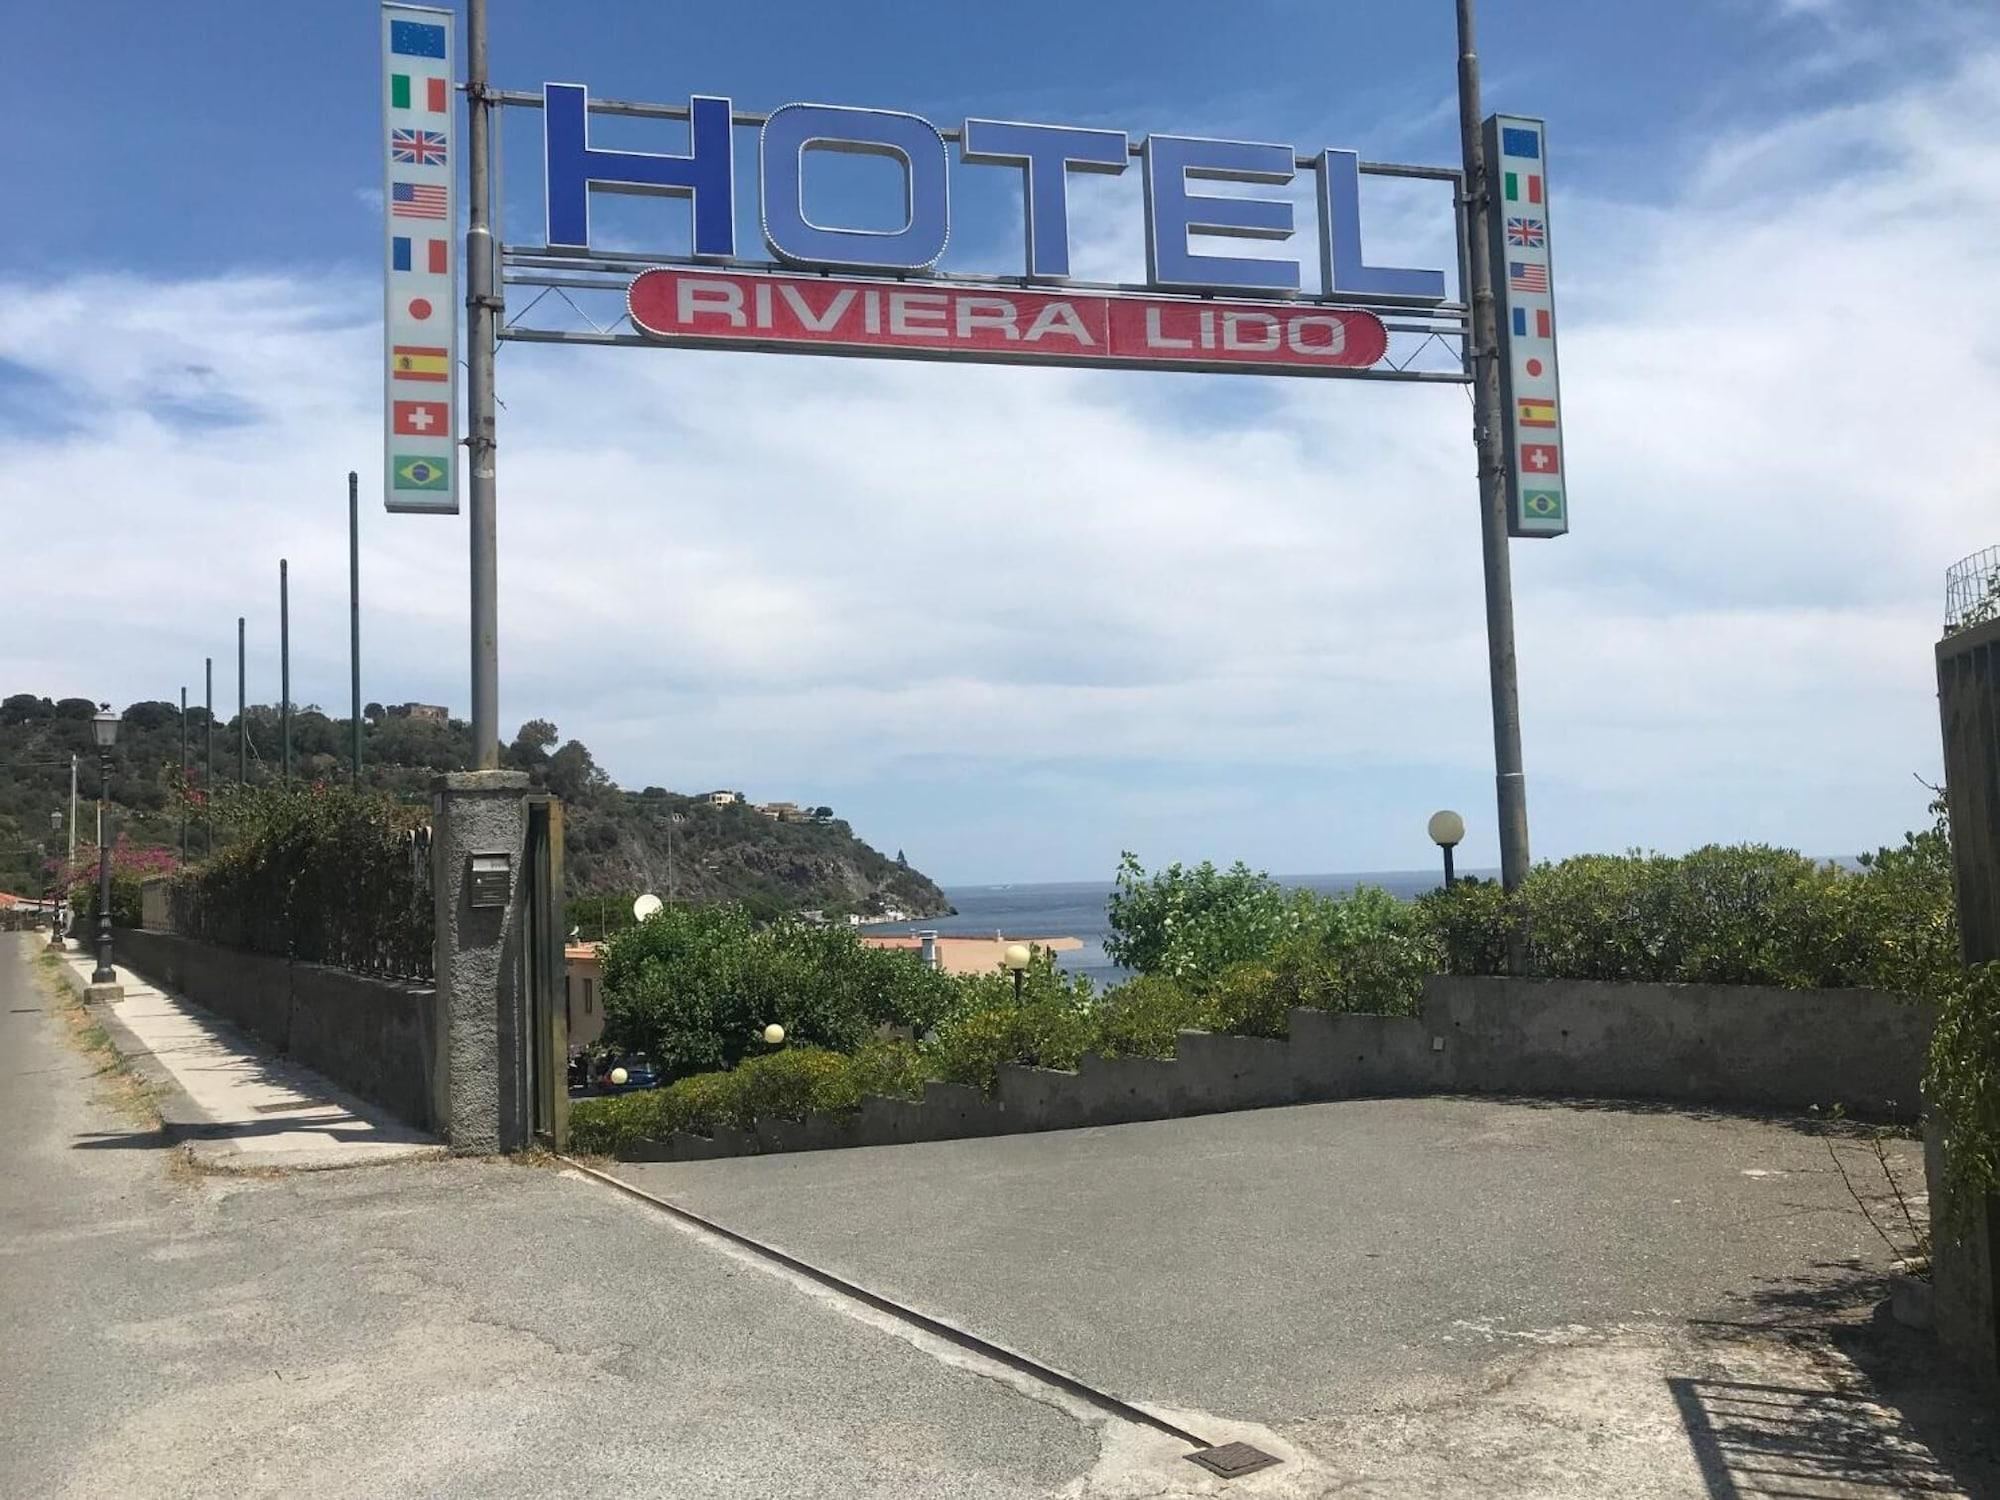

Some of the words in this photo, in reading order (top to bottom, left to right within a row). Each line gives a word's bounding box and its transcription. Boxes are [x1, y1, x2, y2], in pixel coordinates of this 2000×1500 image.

[543, 82, 1446, 302] HOTEL
[676, 278, 1095, 346] RIVIERA
[1145, 307, 1346, 355] LIDO
